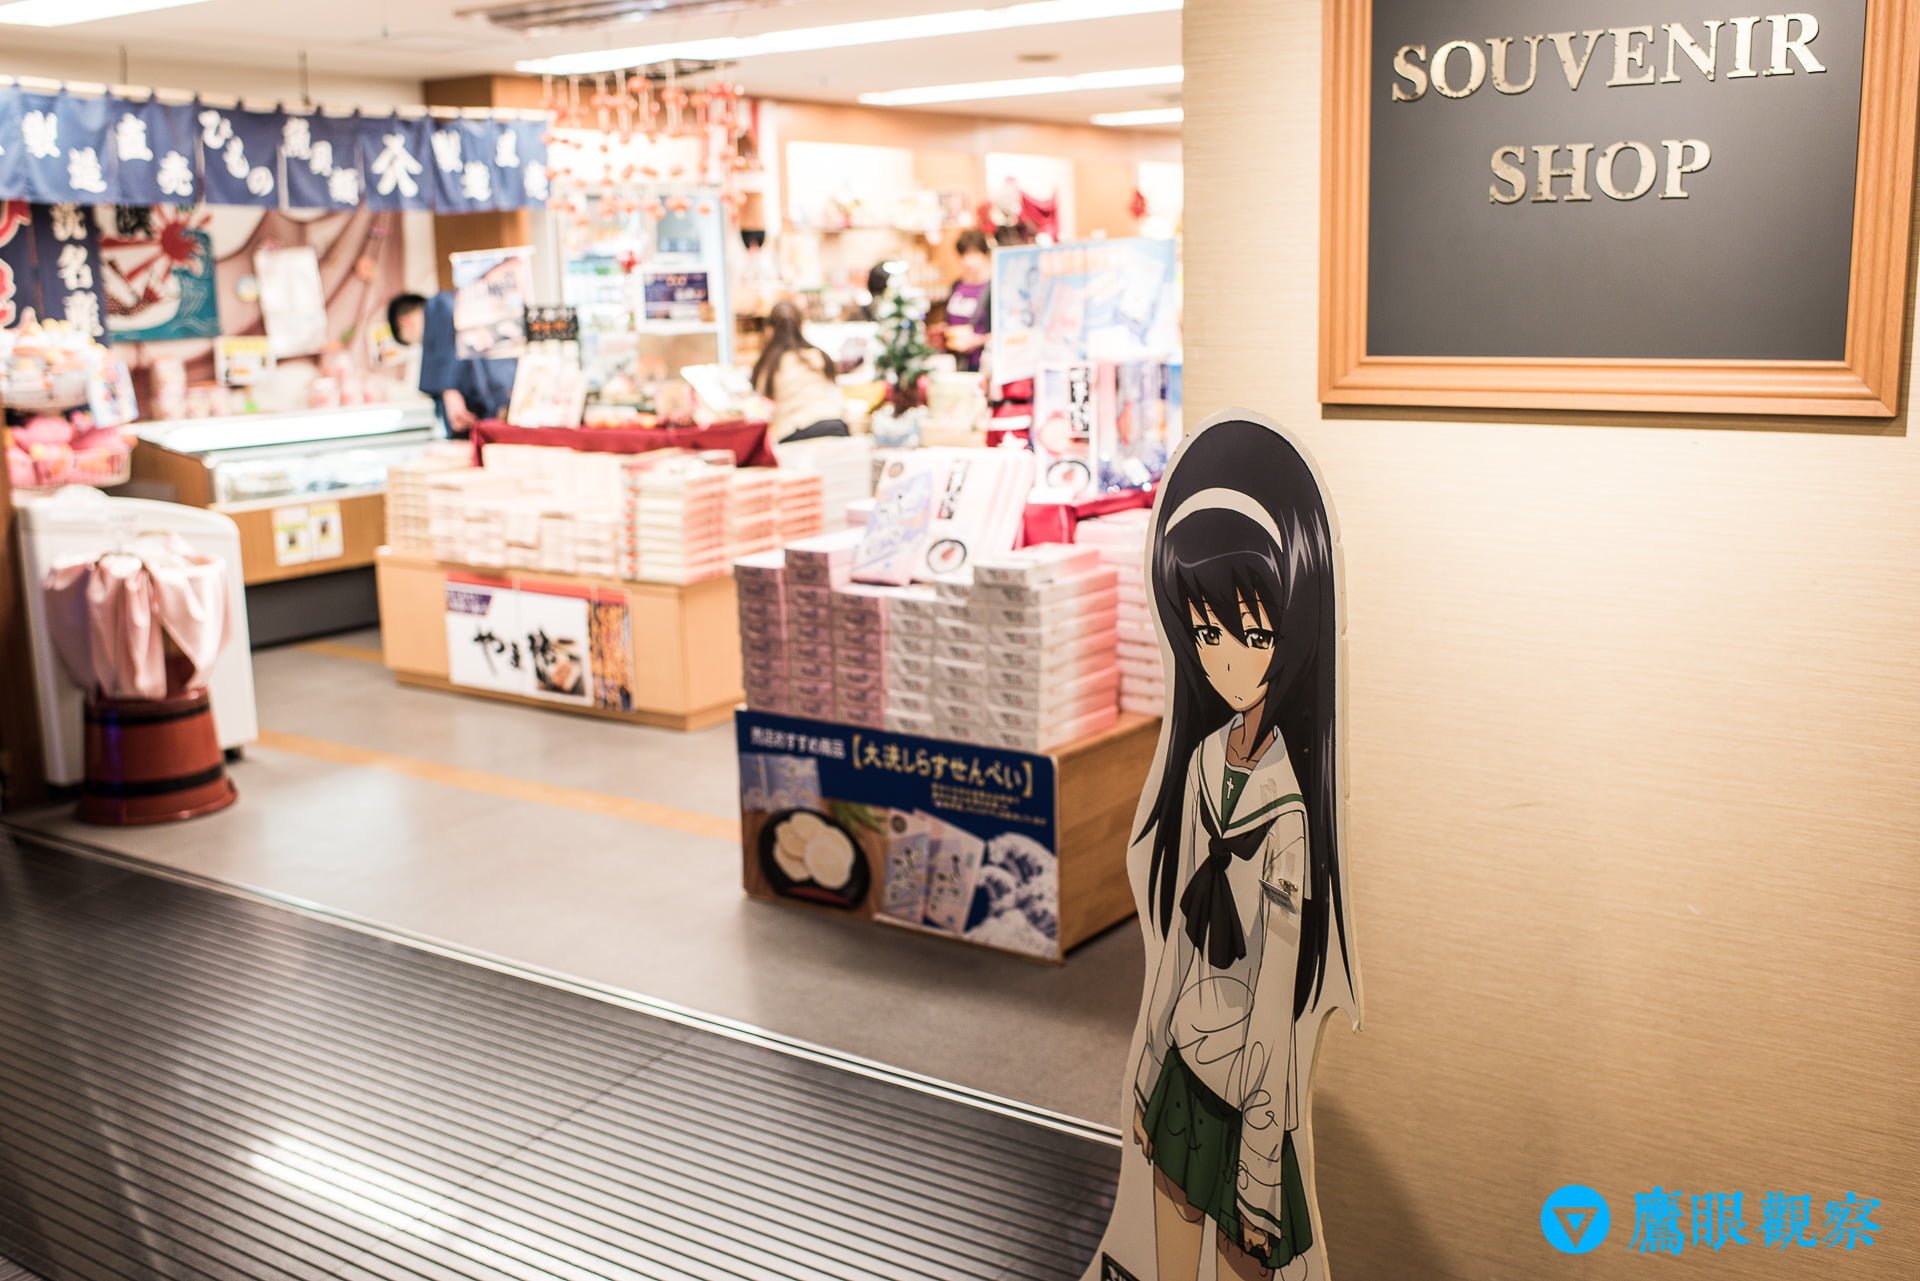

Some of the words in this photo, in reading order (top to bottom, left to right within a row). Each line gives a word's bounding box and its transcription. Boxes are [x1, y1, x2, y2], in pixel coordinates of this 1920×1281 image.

[1392, 12, 1827, 102] SOUVENIR
[198, 110, 275, 197] ひもの
[1488, 139, 1712, 205] SHOP
